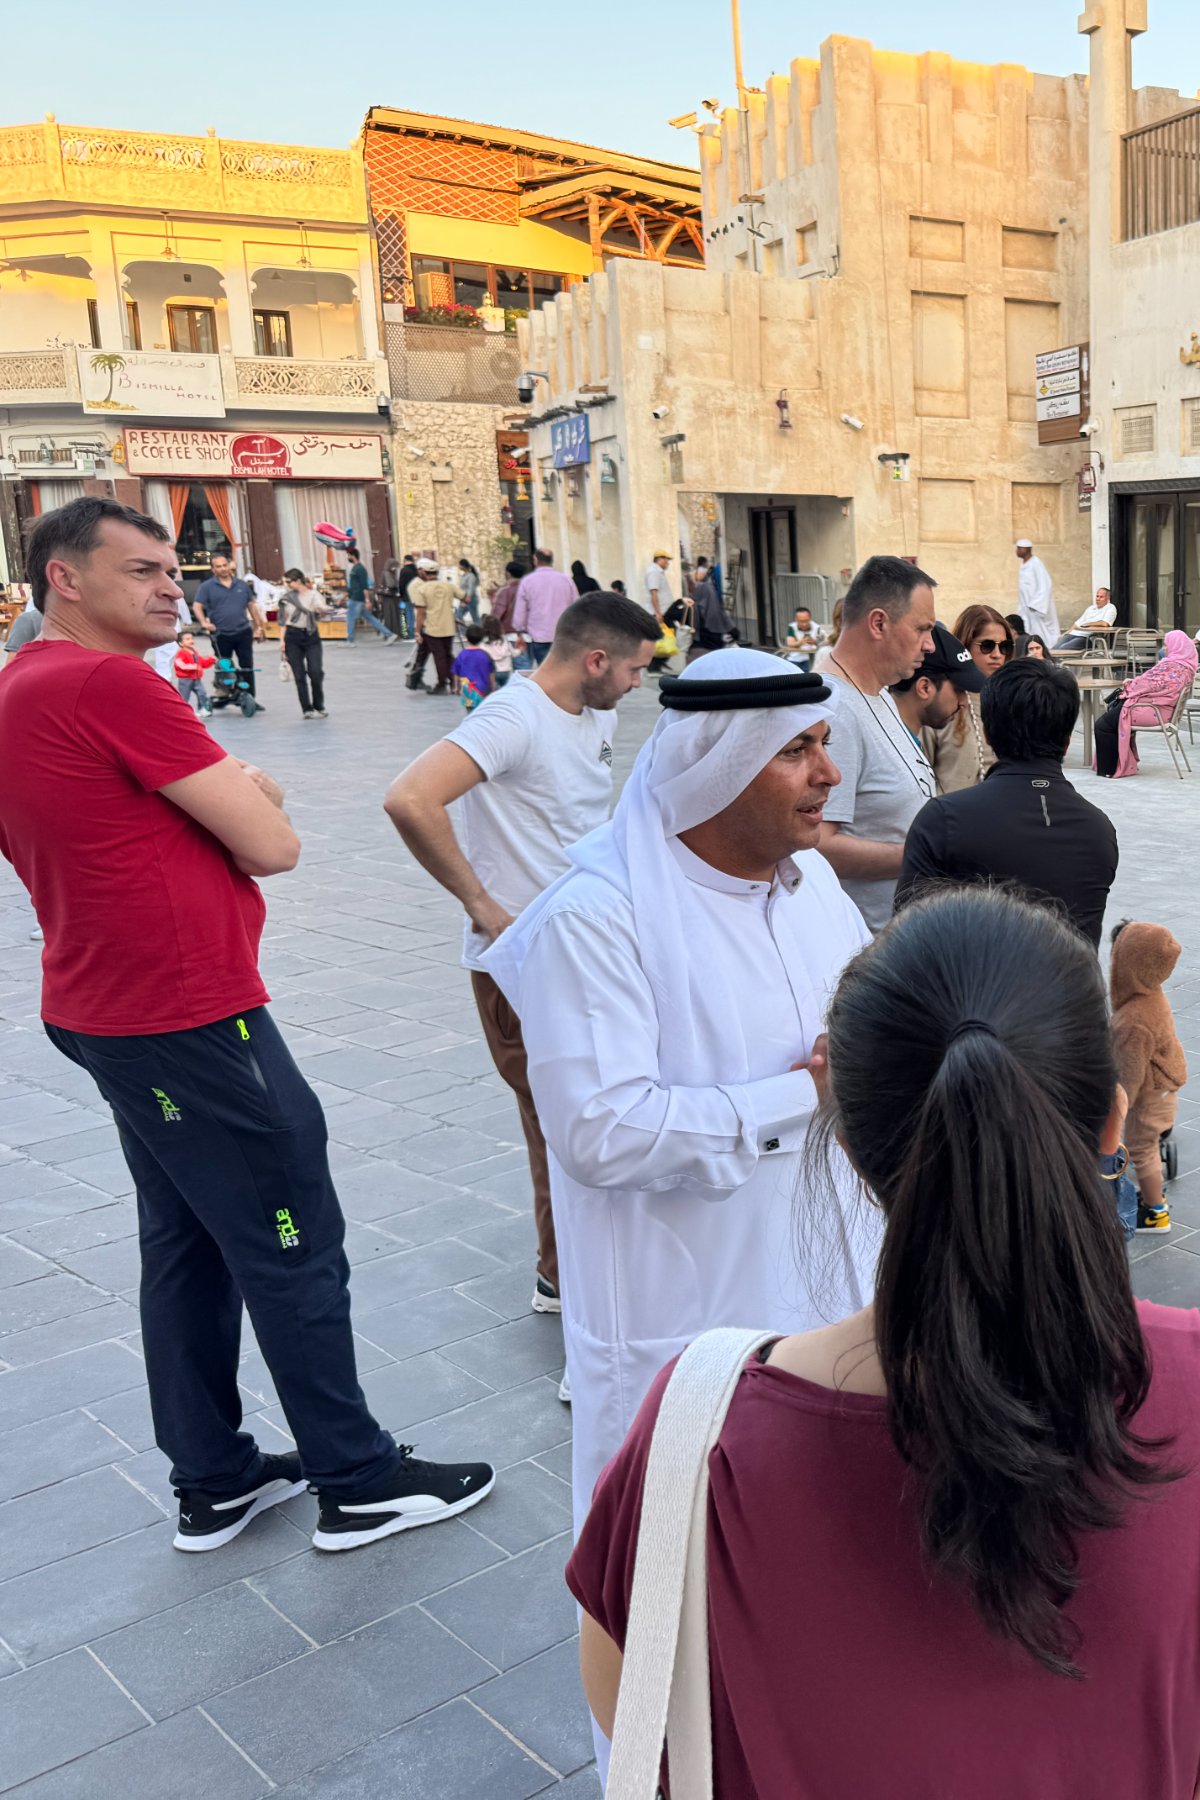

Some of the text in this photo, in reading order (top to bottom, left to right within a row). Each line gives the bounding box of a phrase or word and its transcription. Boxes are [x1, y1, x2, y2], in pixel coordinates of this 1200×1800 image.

[128, 431, 229, 447] RESTAURANT
[141, 445, 193, 460] COFFEE
[196, 447, 229, 460] SHOP
[331, 438, 373, 456] مطعم
[267, 467, 290, 476] HOTEL
